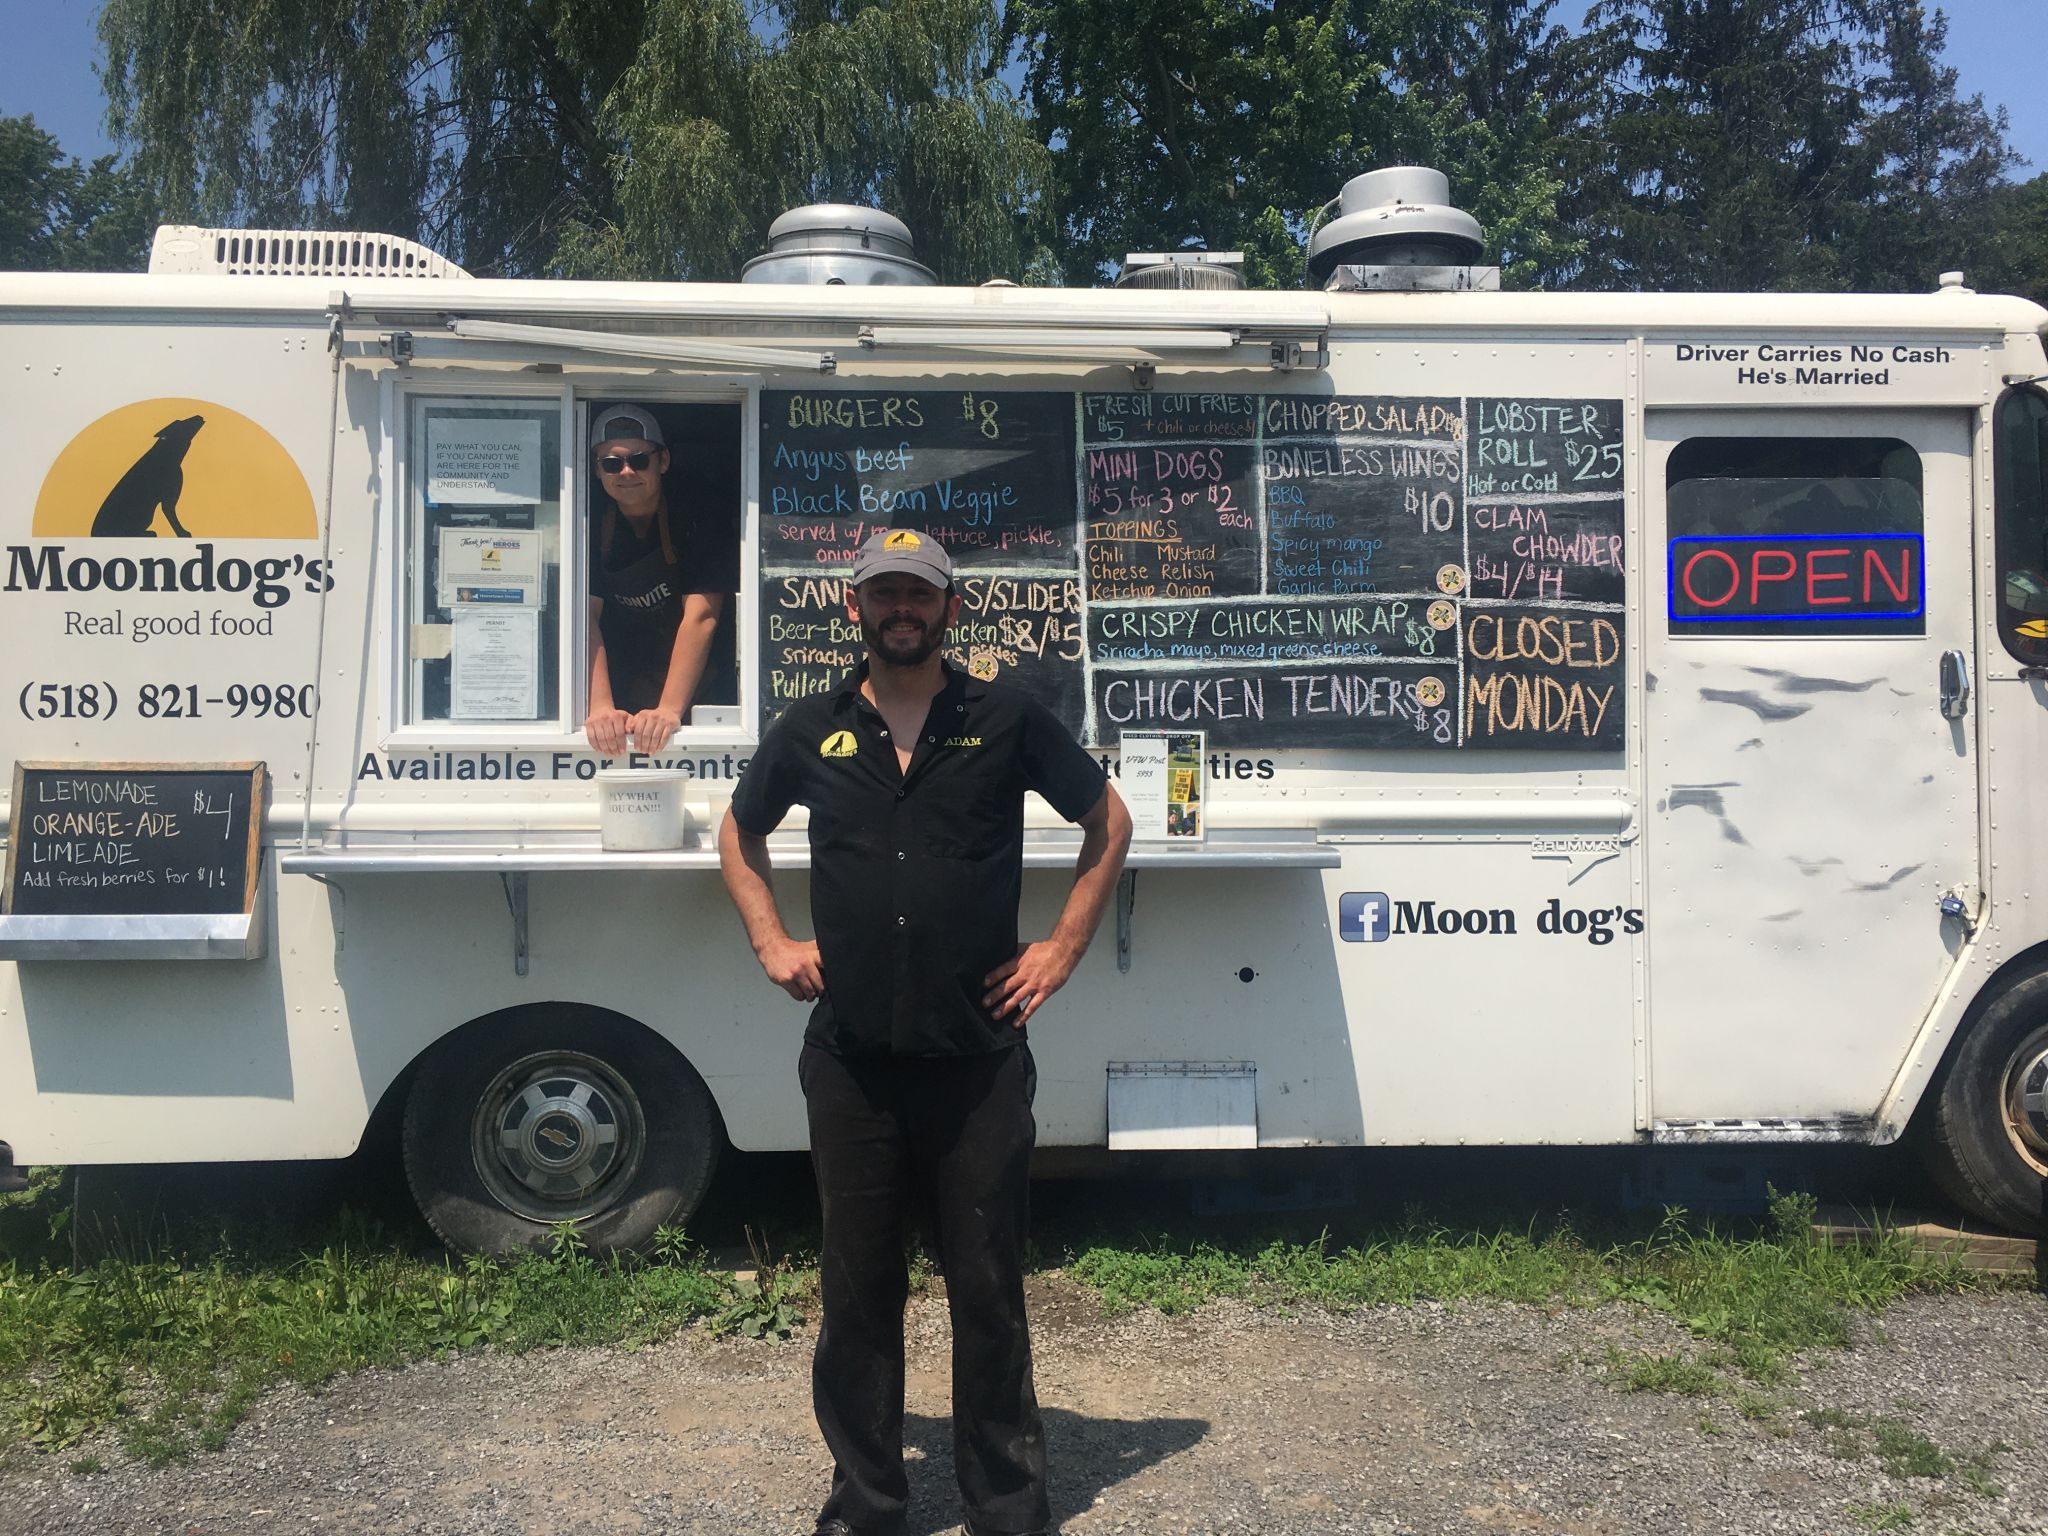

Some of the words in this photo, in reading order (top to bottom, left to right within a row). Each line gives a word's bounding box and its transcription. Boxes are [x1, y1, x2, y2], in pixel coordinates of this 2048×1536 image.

[1676, 344, 1749, 362] Driver
[1757, 345, 1842, 362] Carries
[1851, 345, 1883, 363] No
[1892, 346, 1950, 363] Cash
[1738, 367, 1787, 385] He's
[1795, 368, 1889, 385] Married
[787, 395, 924, 428] BURGERS
[962, 391, 1000, 439] $8
[1085, 395, 1152, 416] FRESH
[1162, 394, 1198, 414] CUT
[1200, 394, 1253, 415] FRIES
[1266, 399, 1367, 433] CHOPPED
[1098, 415, 1125, 441] $5
[1157, 418, 1183, 434] chili
[1188, 423, 1200, 433] or
[1479, 400, 1603, 440] LOBSTER
[436, 442, 452, 450] PAY
[454, 443, 479, 451] WHAT
[481, 443, 500, 451] YOU
[436, 452, 445, 460] IF
[446, 452, 465, 460] YOU
[467, 453, 503, 461] CANNOT
[505, 453, 519, 461] WE
[1478, 437, 1548, 467] ROLL
[1564, 437, 1623, 481] $25
[436, 462, 454, 470] ARE
[456, 462, 480, 470] HERE
[482, 462, 501, 470] FOR
[502, 462, 520, 470] THE
[773, 441, 847, 481] Angus
[855, 441, 914, 473] Beef
[1089, 450, 1138, 482] MINI
[1154, 447, 1223, 481] DOGS
[1263, 447, 1384, 481] BONELESS
[1390, 447, 1461, 484] WINGS
[436, 471, 489, 479] COMMUNITY
[491, 472, 510, 480] AND
[437, 481, 496, 489] UNDERSTAND
[1469, 472, 1497, 497] Hot
[1501, 478, 1520, 493] or
[1521, 471, 1558, 493] Cold
[772, 484, 852, 516] Black
[858, 482, 926, 513] Bean
[935, 479, 1018, 525] Veggie
[1088, 483, 1123, 516] $5
[1129, 485, 1153, 508] for
[1158, 486, 1174, 514] 3
[1181, 491, 1200, 506] or
[1208, 484, 1238, 513] $2
[1269, 485, 1306, 506] BBQ
[1219, 509, 1253, 530] each
[1271, 510, 1336, 531] Buffalo
[1403, 486, 1455, 535] $10
[1474, 504, 1549, 535] CLAM
[778, 521, 836, 542] served
[1089, 519, 1178, 539] TOPPINGS
[1089, 544, 1123, 563] Chili
[1157, 543, 1216, 561] Mustard
[1271, 531, 1320, 560] Spicy
[1326, 537, 1383, 561] mango
[1512, 531, 1625, 576] CHOWDER
[3, 543, 335, 608] Moondog's
[1091, 564, 1149, 581] Cheese
[1161, 563, 1215, 581] Relish
[1273, 558, 1326, 577] Sweet
[1332, 559, 1370, 577] Chili
[1682, 548, 1910, 608] OPEN
[1092, 583, 1155, 602] Ketchup
[1165, 582, 1212, 599] Onion
[1278, 578, 1325, 596] Garlic
[1332, 578, 1377, 595] Parm
[64, 609, 124, 635] Real
[132, 610, 201, 643] good
[209, 610, 274, 636] food
[944, 619, 997, 645] hicken
[1101, 608, 1200, 640] CRISPY
[1211, 607, 1325, 639] CHICKEN
[1332, 602, 1408, 636] WRAP
[1404, 616, 1436, 656] $8
[1467, 614, 1620, 669] CLOSED
[781, 646, 855, 667] Sriracha
[1096, 640, 1165, 660] Sriracha
[1219, 642, 1265, 658] mixed
[771, 669, 832, 699] Pulled
[19, 681, 118, 721] (518)
[138, 683, 321, 719] 821-9980
[1104, 677, 1265, 723] CHICKEN
[1281, 673, 1424, 721] TENDERS
[1467, 671, 1614, 738] MONDAY
[1414, 708, 1451, 743] $8
[944, 737, 983, 746] ADAM
[357, 752, 536, 781] Available
[626, 791, 660, 801] WHAT
[39, 780, 159, 806] LEMONADE
[193, 789, 234, 840] $4
[33, 811, 181, 838] ORANGE-ADE
[33, 841, 140, 867] LIMEADE
[1531, 840, 1620, 851] GRUMMAN
[23, 871, 51, 888] Add
[57, 870, 98, 888] fresh
[102, 869, 156, 887] berries
[166, 867, 190, 884] for
[1392, 900, 1517, 935] Moon
[1536, 898, 1645, 946] dog's
